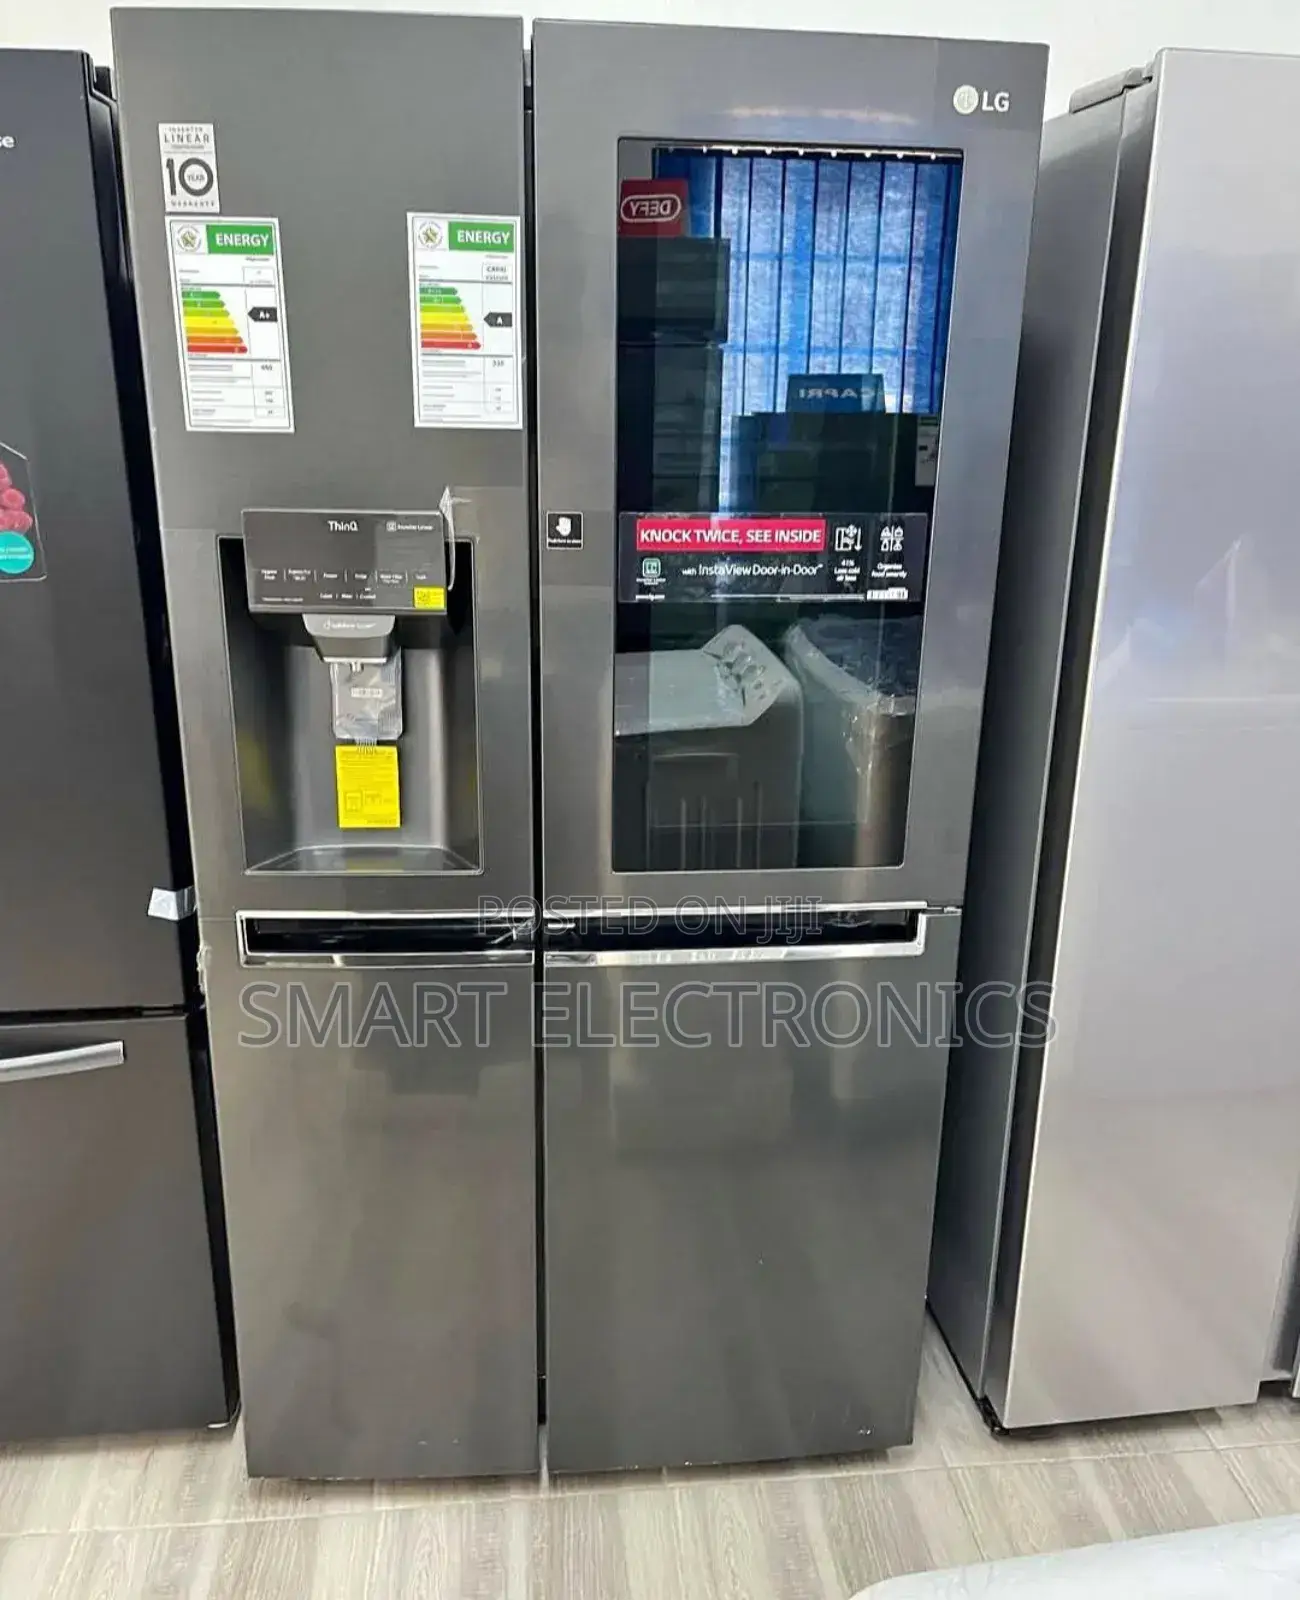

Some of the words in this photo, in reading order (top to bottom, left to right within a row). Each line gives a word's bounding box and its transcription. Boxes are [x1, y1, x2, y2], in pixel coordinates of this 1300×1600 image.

[982, 90, 1010, 112] LG
[164, 133, 209, 143] LINEAR
[166, 157, 213, 197] 10
[215, 232, 269, 247] ENERGY
[456, 229, 510, 245] ENERGY
[496, 316, 503, 325] A
[328, 520, 358, 531] ThinQ
[640, 528, 692, 543] KNOCK
[693, 528, 743, 545] TWICE,
[746, 528, 772, 543] SEE
[775, 528, 821, 543] INSIDE
[699, 563, 751, 577] InstaView
